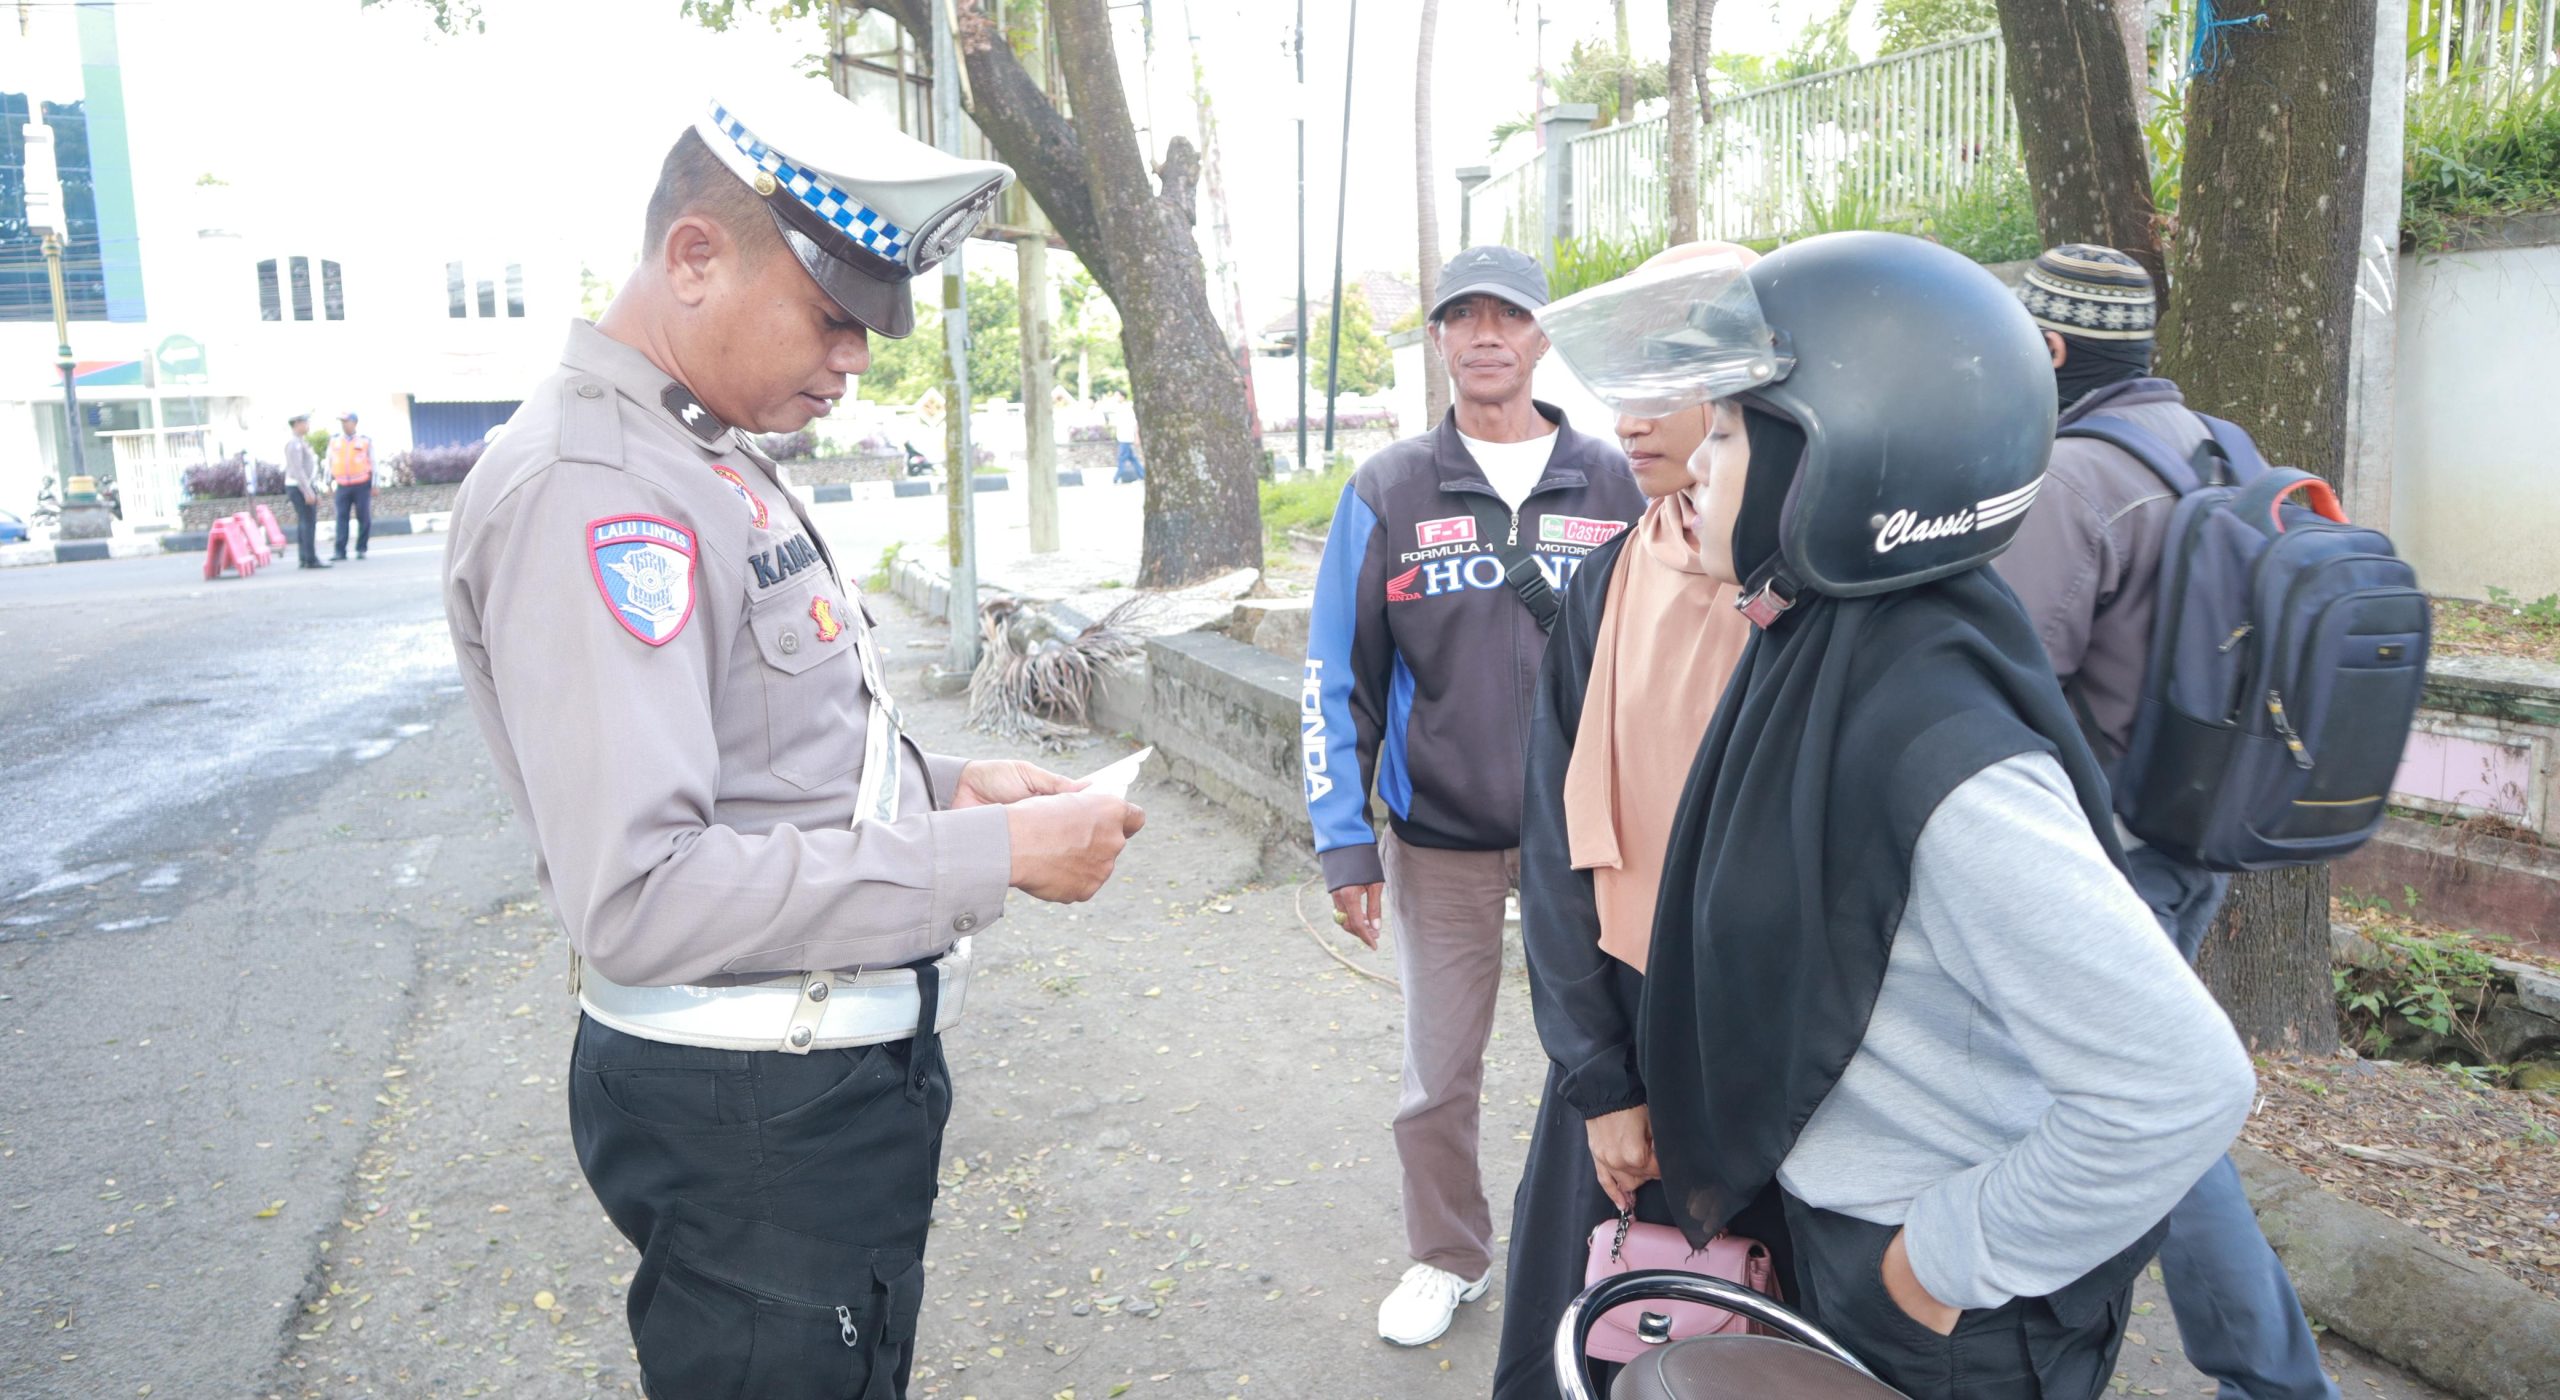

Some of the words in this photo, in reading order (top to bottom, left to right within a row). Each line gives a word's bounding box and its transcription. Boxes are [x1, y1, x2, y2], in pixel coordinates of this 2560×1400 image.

[598, 521, 637, 541] LALU
[641, 520, 687, 548] LINTAS
[1423, 520, 1469, 543] F-1
[1875, 508, 1975, 553] Classic
[1401, 542, 1480, 563] FORMULA
[1485, 543, 1494, 552] 1
[1387, 592, 1422, 602] ONDA
[1302, 658, 1333, 803] HONDA
